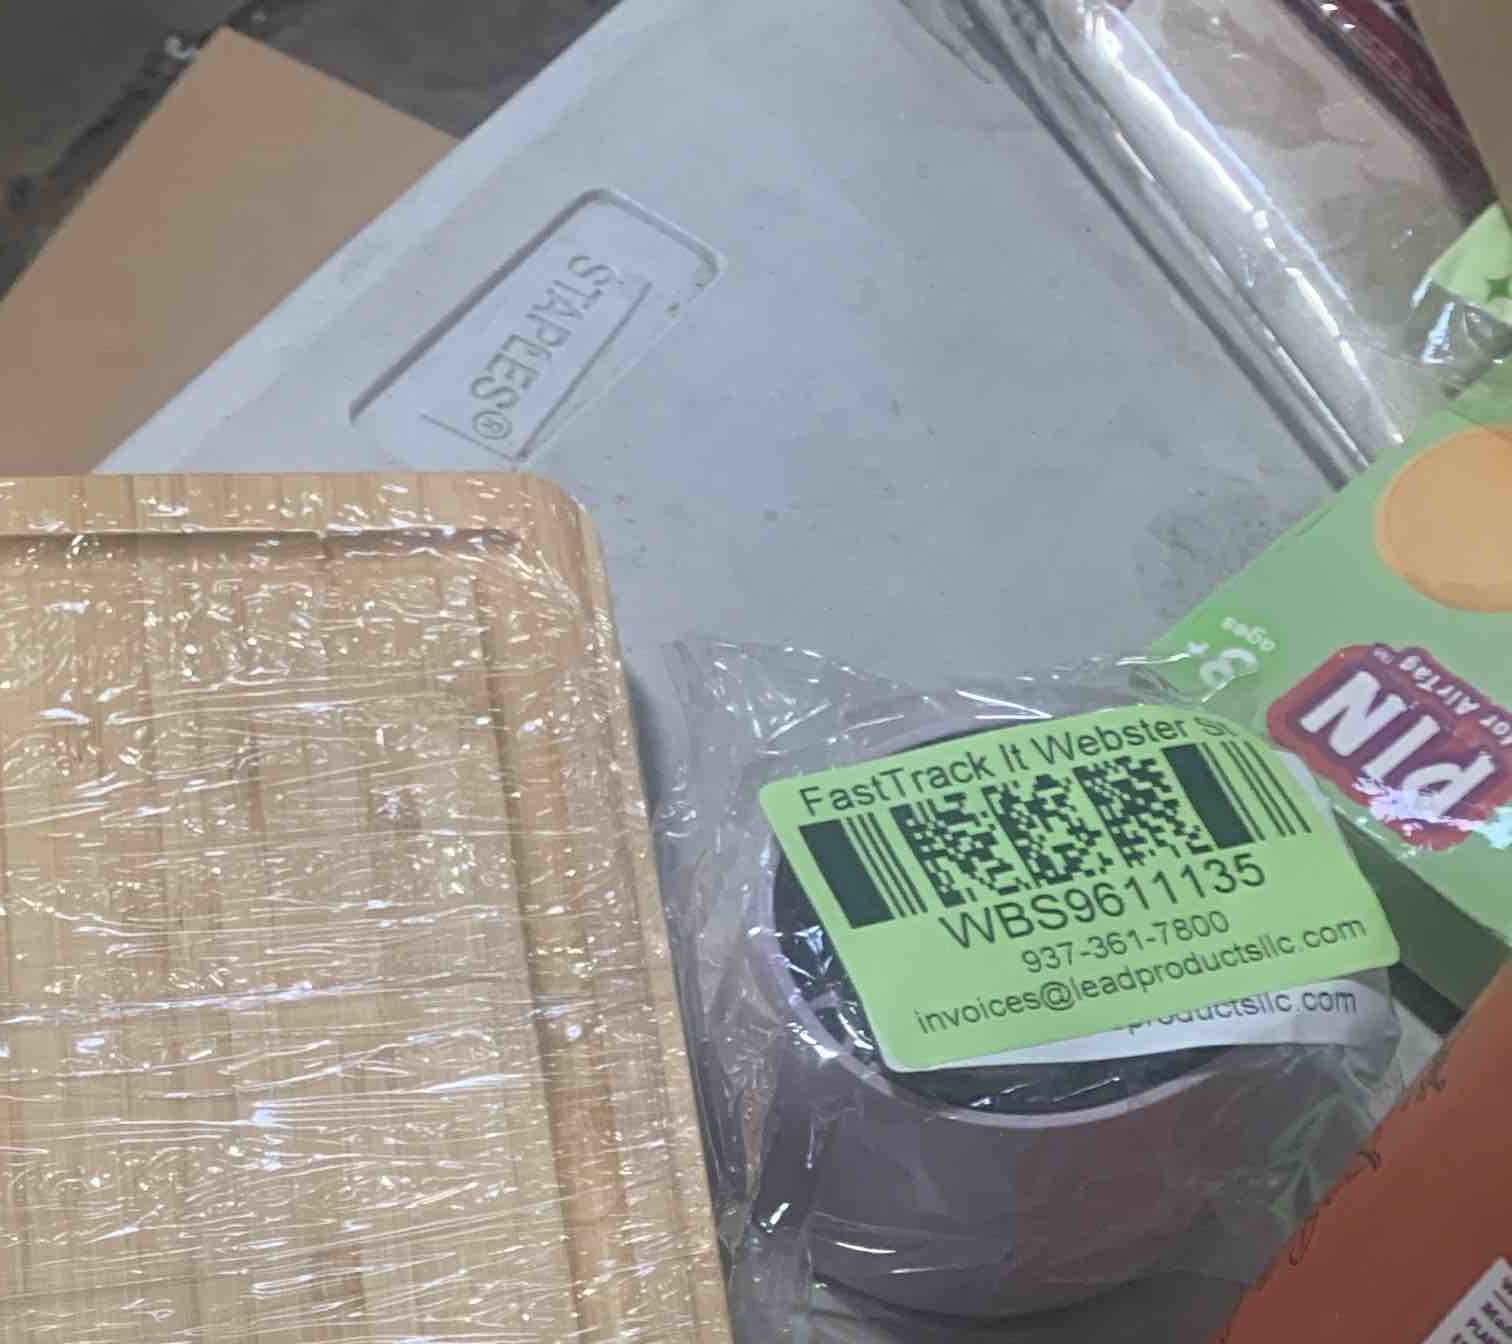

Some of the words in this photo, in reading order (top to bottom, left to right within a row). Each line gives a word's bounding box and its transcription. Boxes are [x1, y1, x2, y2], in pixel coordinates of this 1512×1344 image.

[798, 752, 996, 817] FastTrack
[999, 736, 1028, 775] It
[1033, 717, 1189, 769] Webster
[1300, 670, 1495, 817] PIN
[939, 853, 1266, 949] WBS9611135
[1020, 910, 1231, 974] 937-361-7800
[916, 915, 1368, 1035] invoices@leadproductsllc.com
